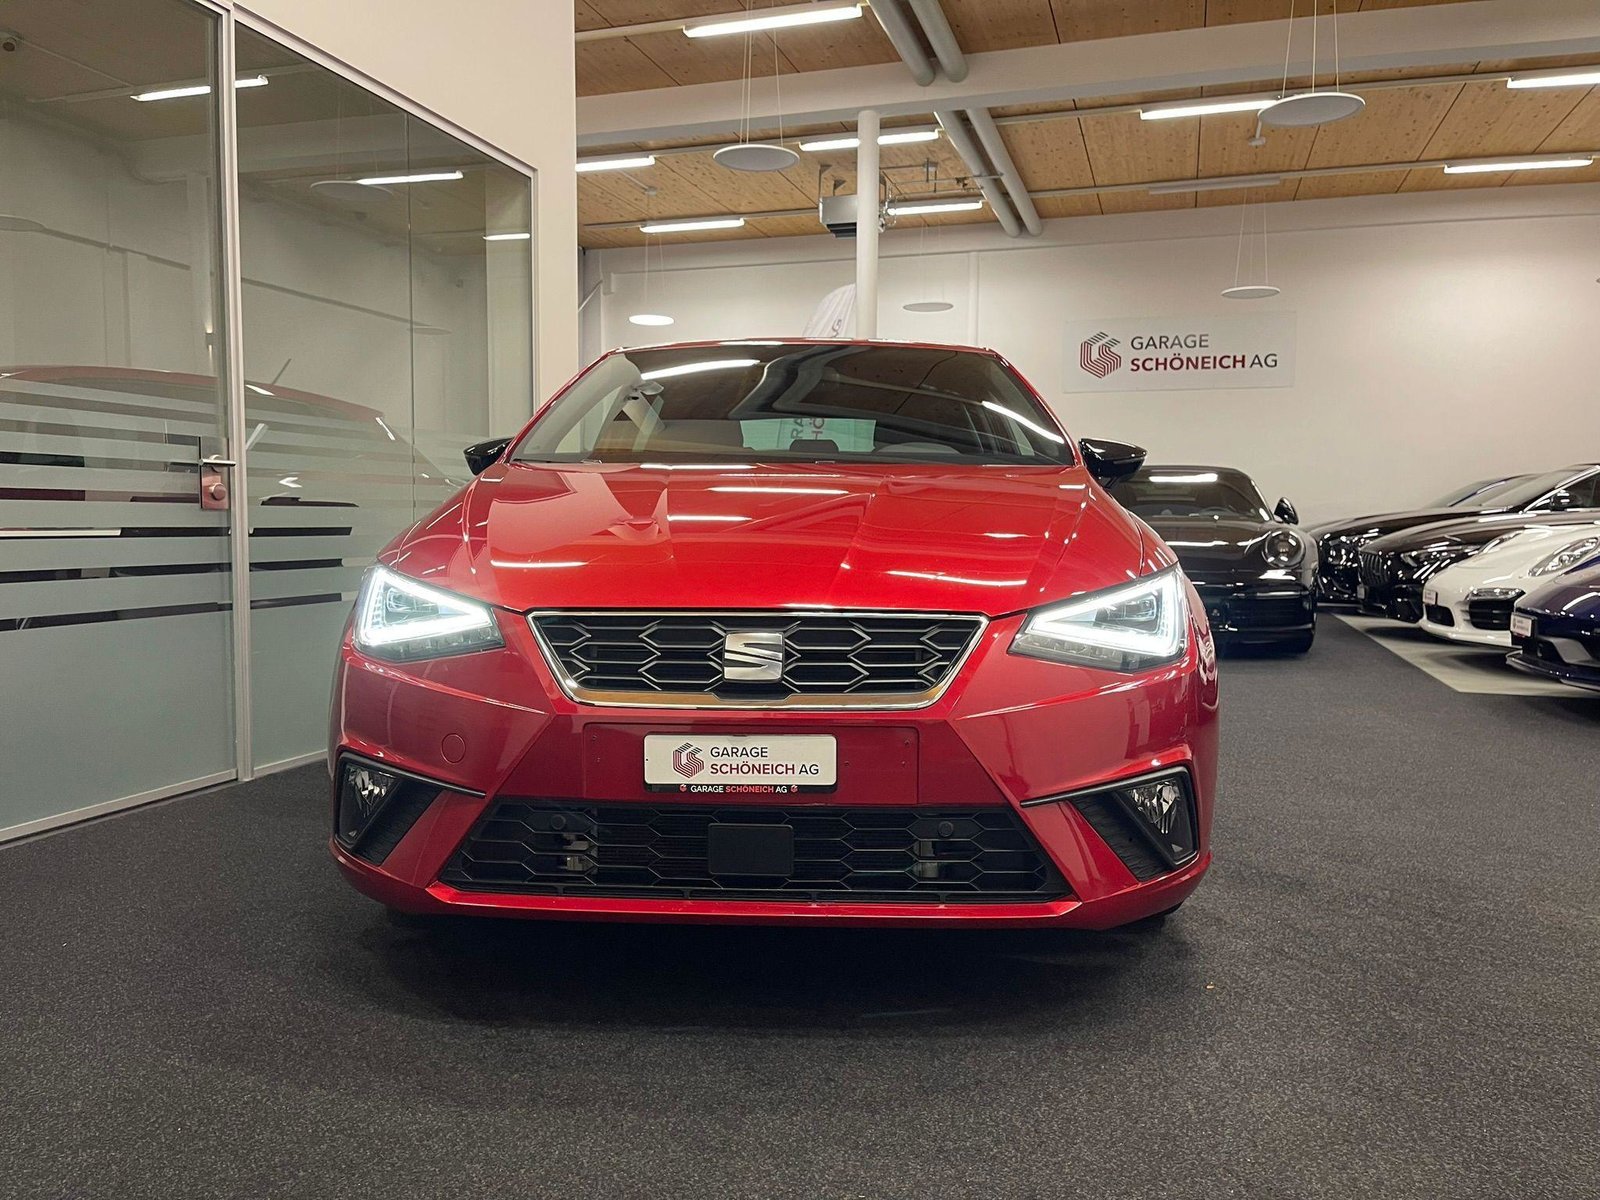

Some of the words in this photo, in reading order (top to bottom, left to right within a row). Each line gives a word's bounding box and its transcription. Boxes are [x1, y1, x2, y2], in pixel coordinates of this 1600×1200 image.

[1131, 334, 1209, 350] GARAGE
[1130, 353, 1246, 371] SCHÖNEICH
[1249, 353, 1278, 368] AG
[710, 746, 768, 758] GARAGE
[710, 761, 795, 775] SCHÖNEICH
[798, 763, 819, 775] AG
[690, 785, 724, 793] GARAGE
[725, 785, 774, 793] SCHÖNEICH
[775, 785, 788, 793] AG
